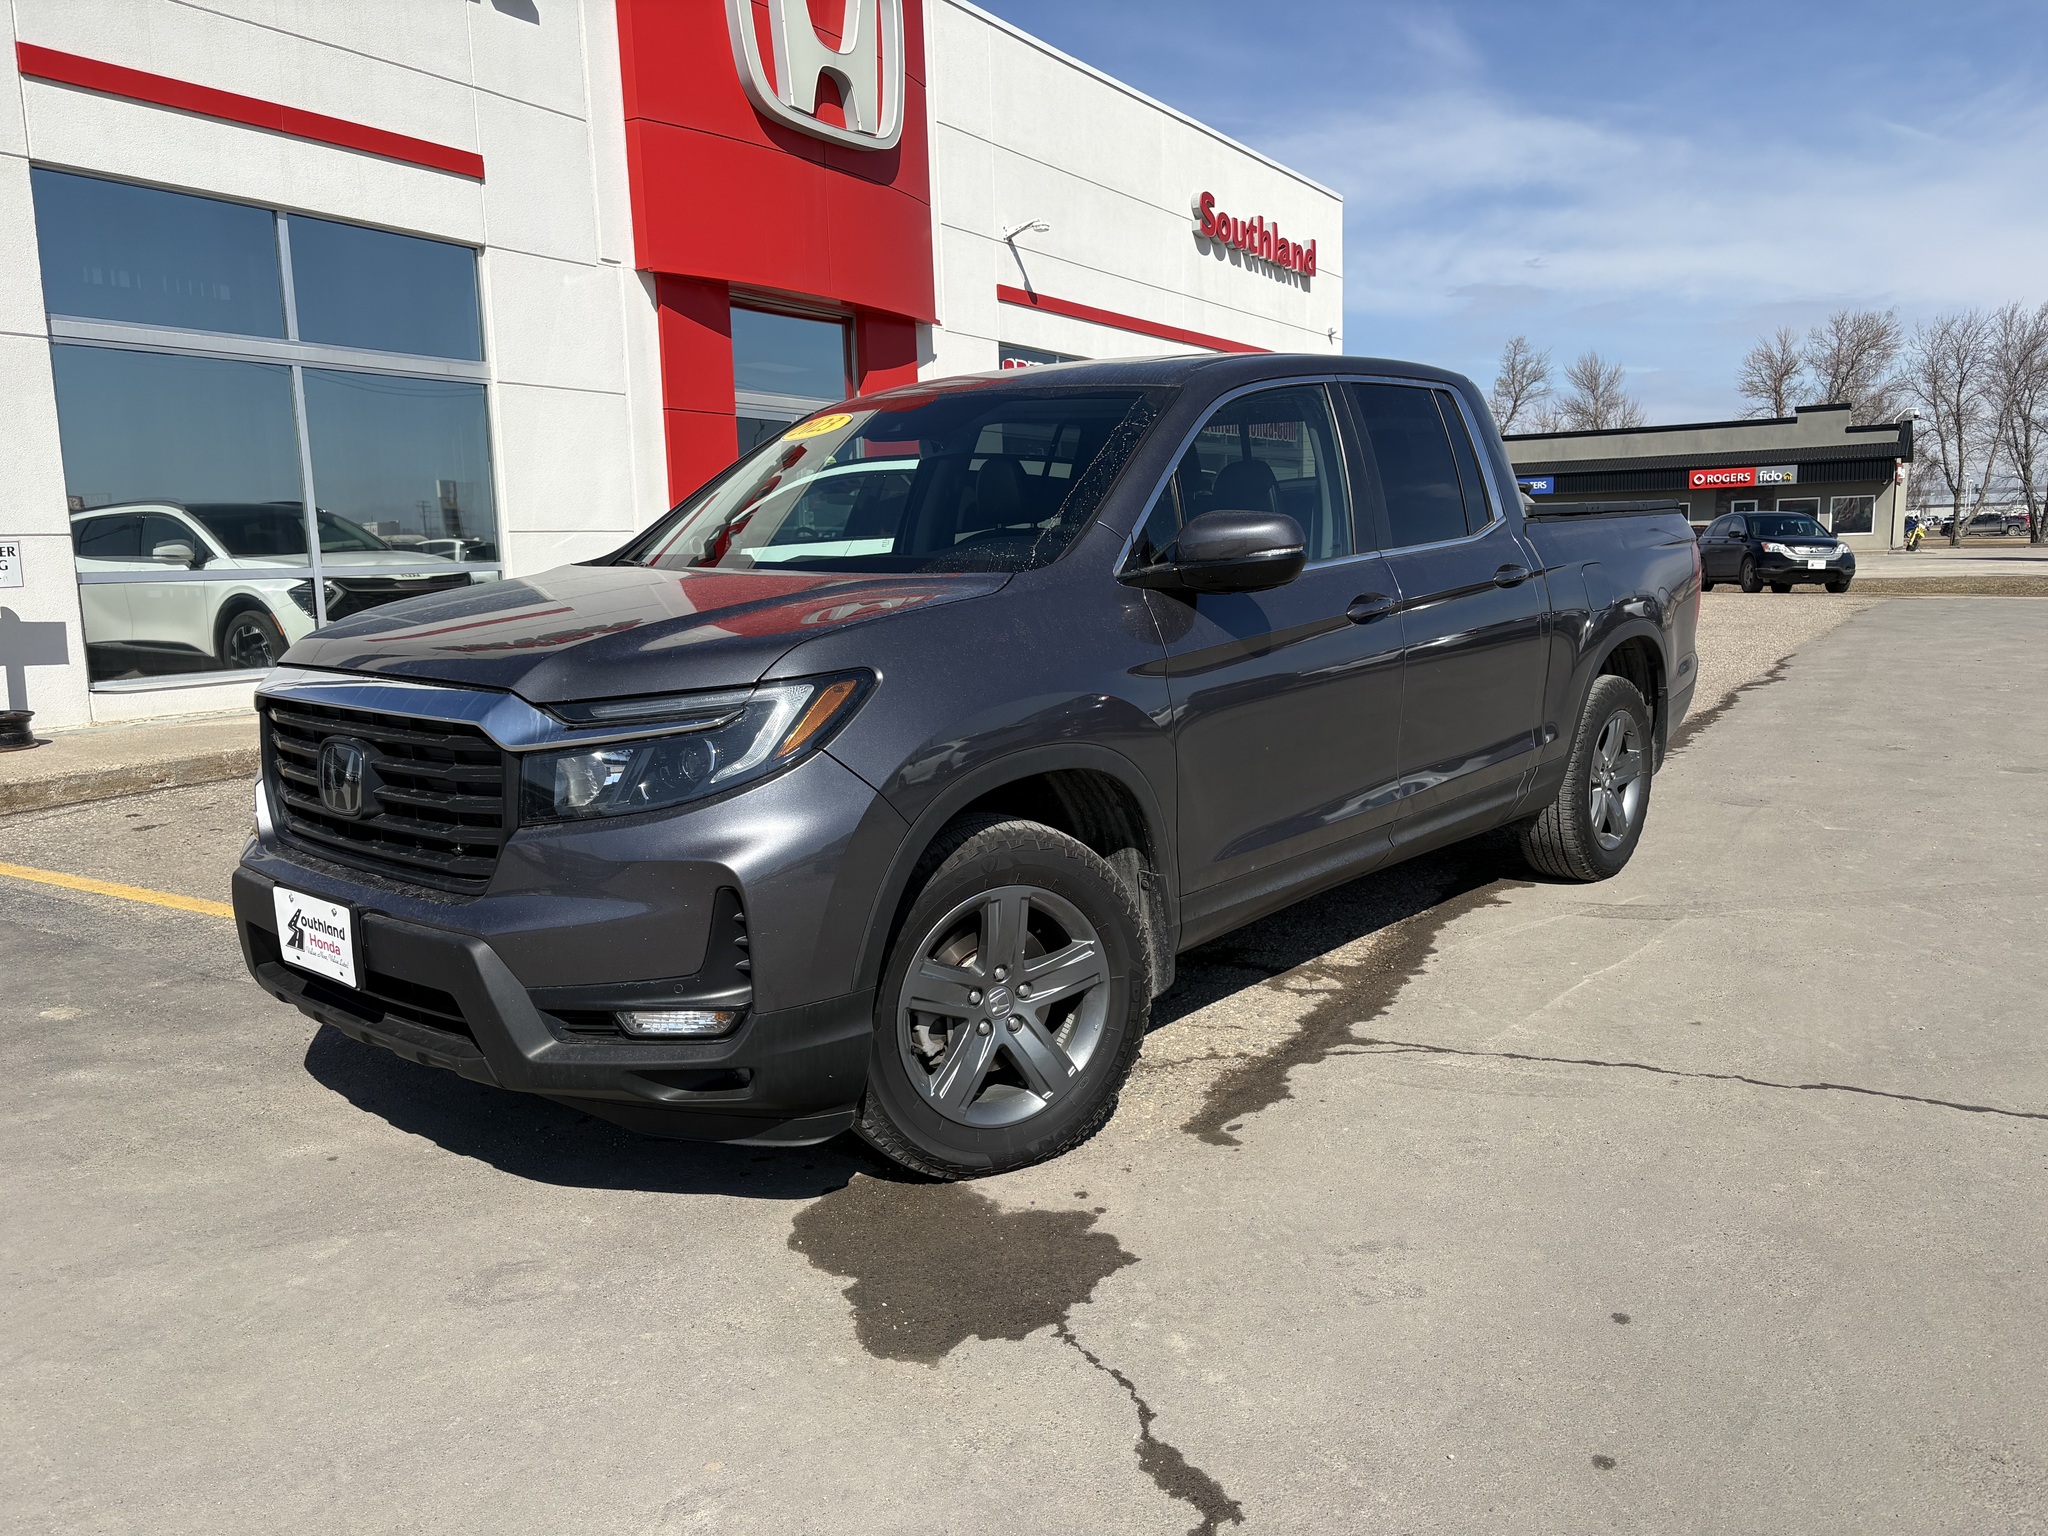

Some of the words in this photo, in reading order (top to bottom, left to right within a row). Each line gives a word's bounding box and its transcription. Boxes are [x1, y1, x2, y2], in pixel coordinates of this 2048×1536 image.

[1198, 191, 1316, 277] Southland
[1707, 472, 1751, 483] ROGERS
[1759, 470, 1783, 482] fido
[309, 933, 341, 956] Honda
